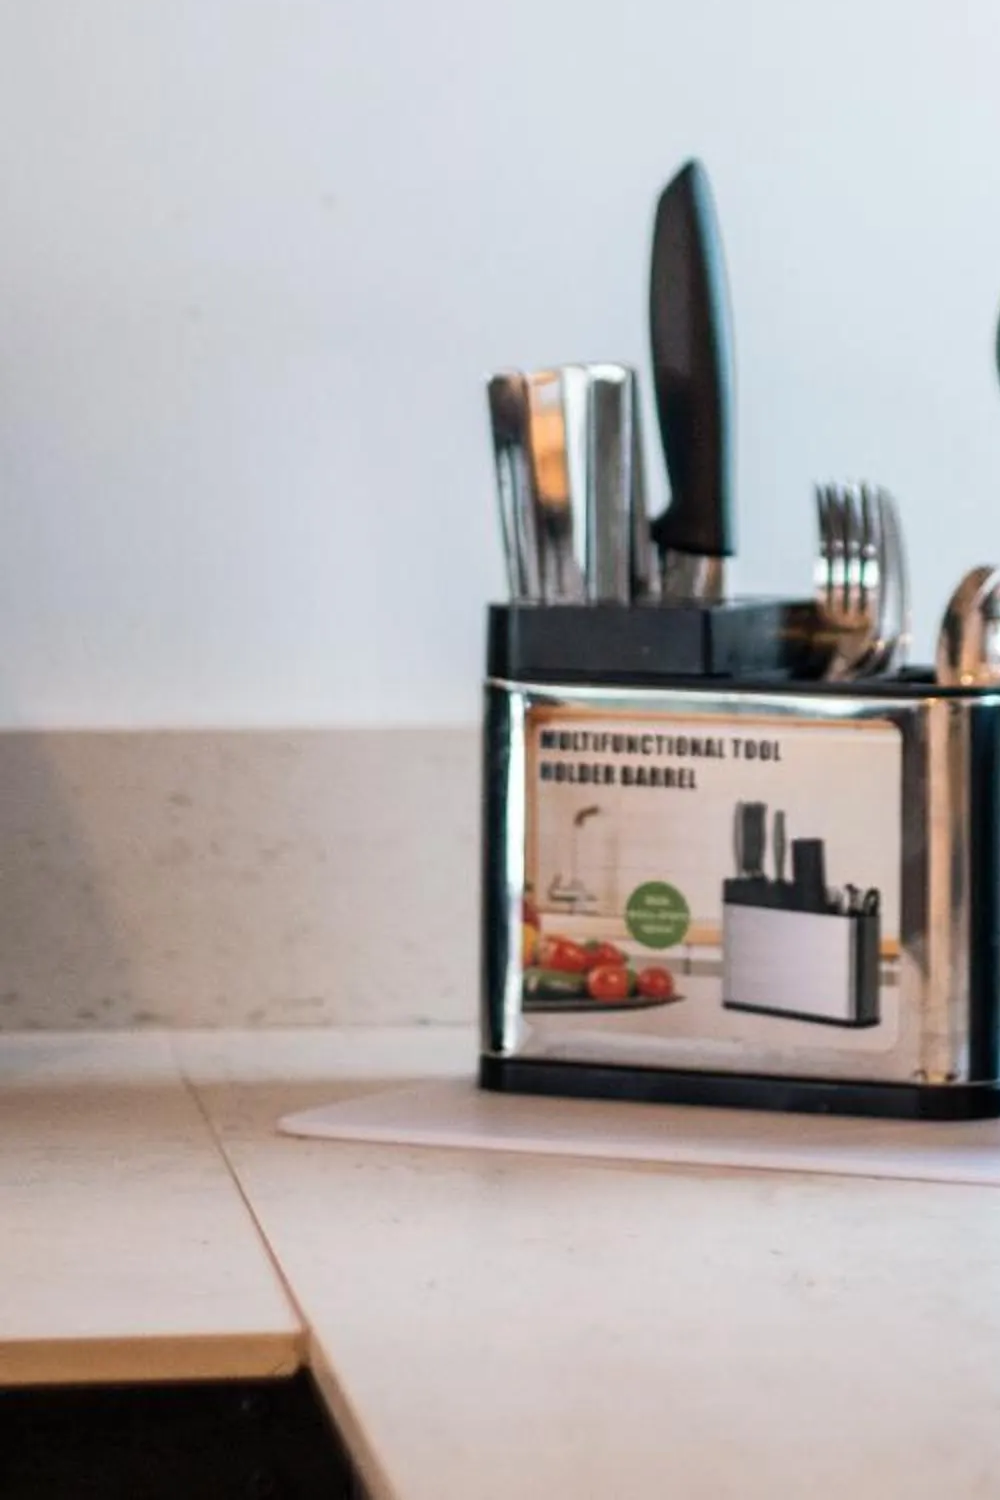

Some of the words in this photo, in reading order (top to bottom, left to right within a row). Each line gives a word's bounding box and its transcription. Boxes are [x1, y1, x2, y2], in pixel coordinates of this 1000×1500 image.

[540, 730, 726, 759] MULTIFUNCTIONAL
[732, 739, 782, 762] TOOL
[540, 762, 616, 785] HOLDER
[620, 766, 697, 789] BARREL
